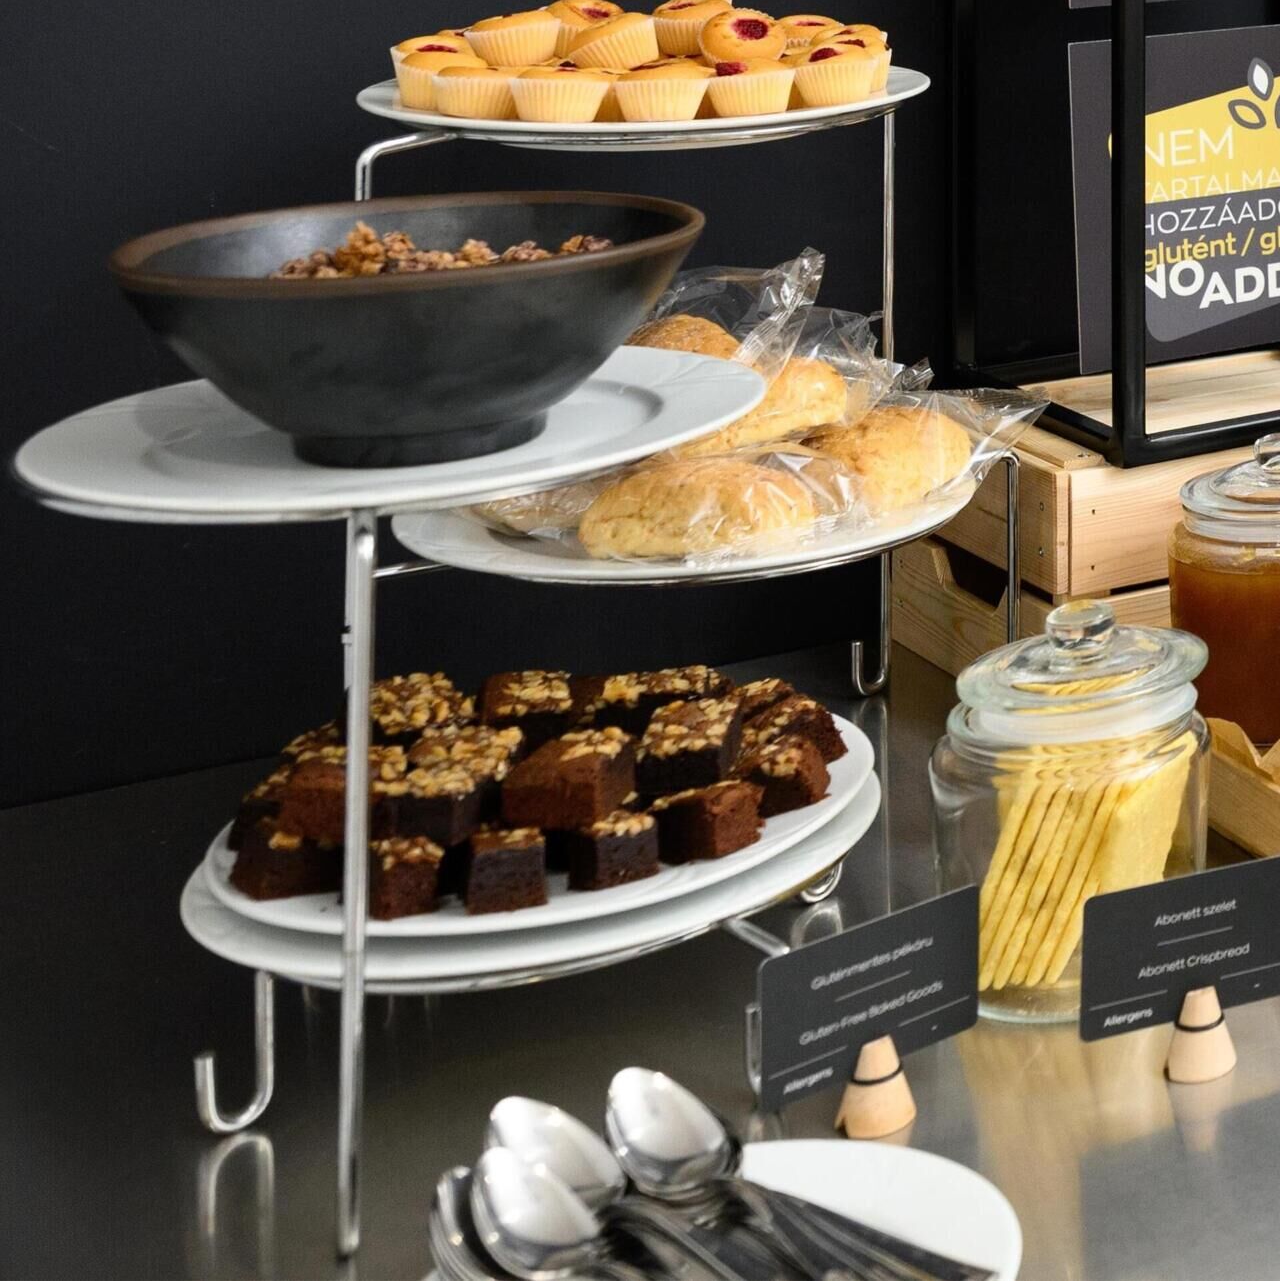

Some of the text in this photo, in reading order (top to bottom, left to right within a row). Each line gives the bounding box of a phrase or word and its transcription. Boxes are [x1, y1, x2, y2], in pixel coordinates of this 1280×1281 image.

[1145, 235, 1237, 271] glutént
[1154, 906, 1201, 927] Abonett
[1137, 943, 1250, 980] Abonett Crispbread
[906, 980, 944, 1003] Goods
[1104, 1007, 1153, 1028] Allergens
